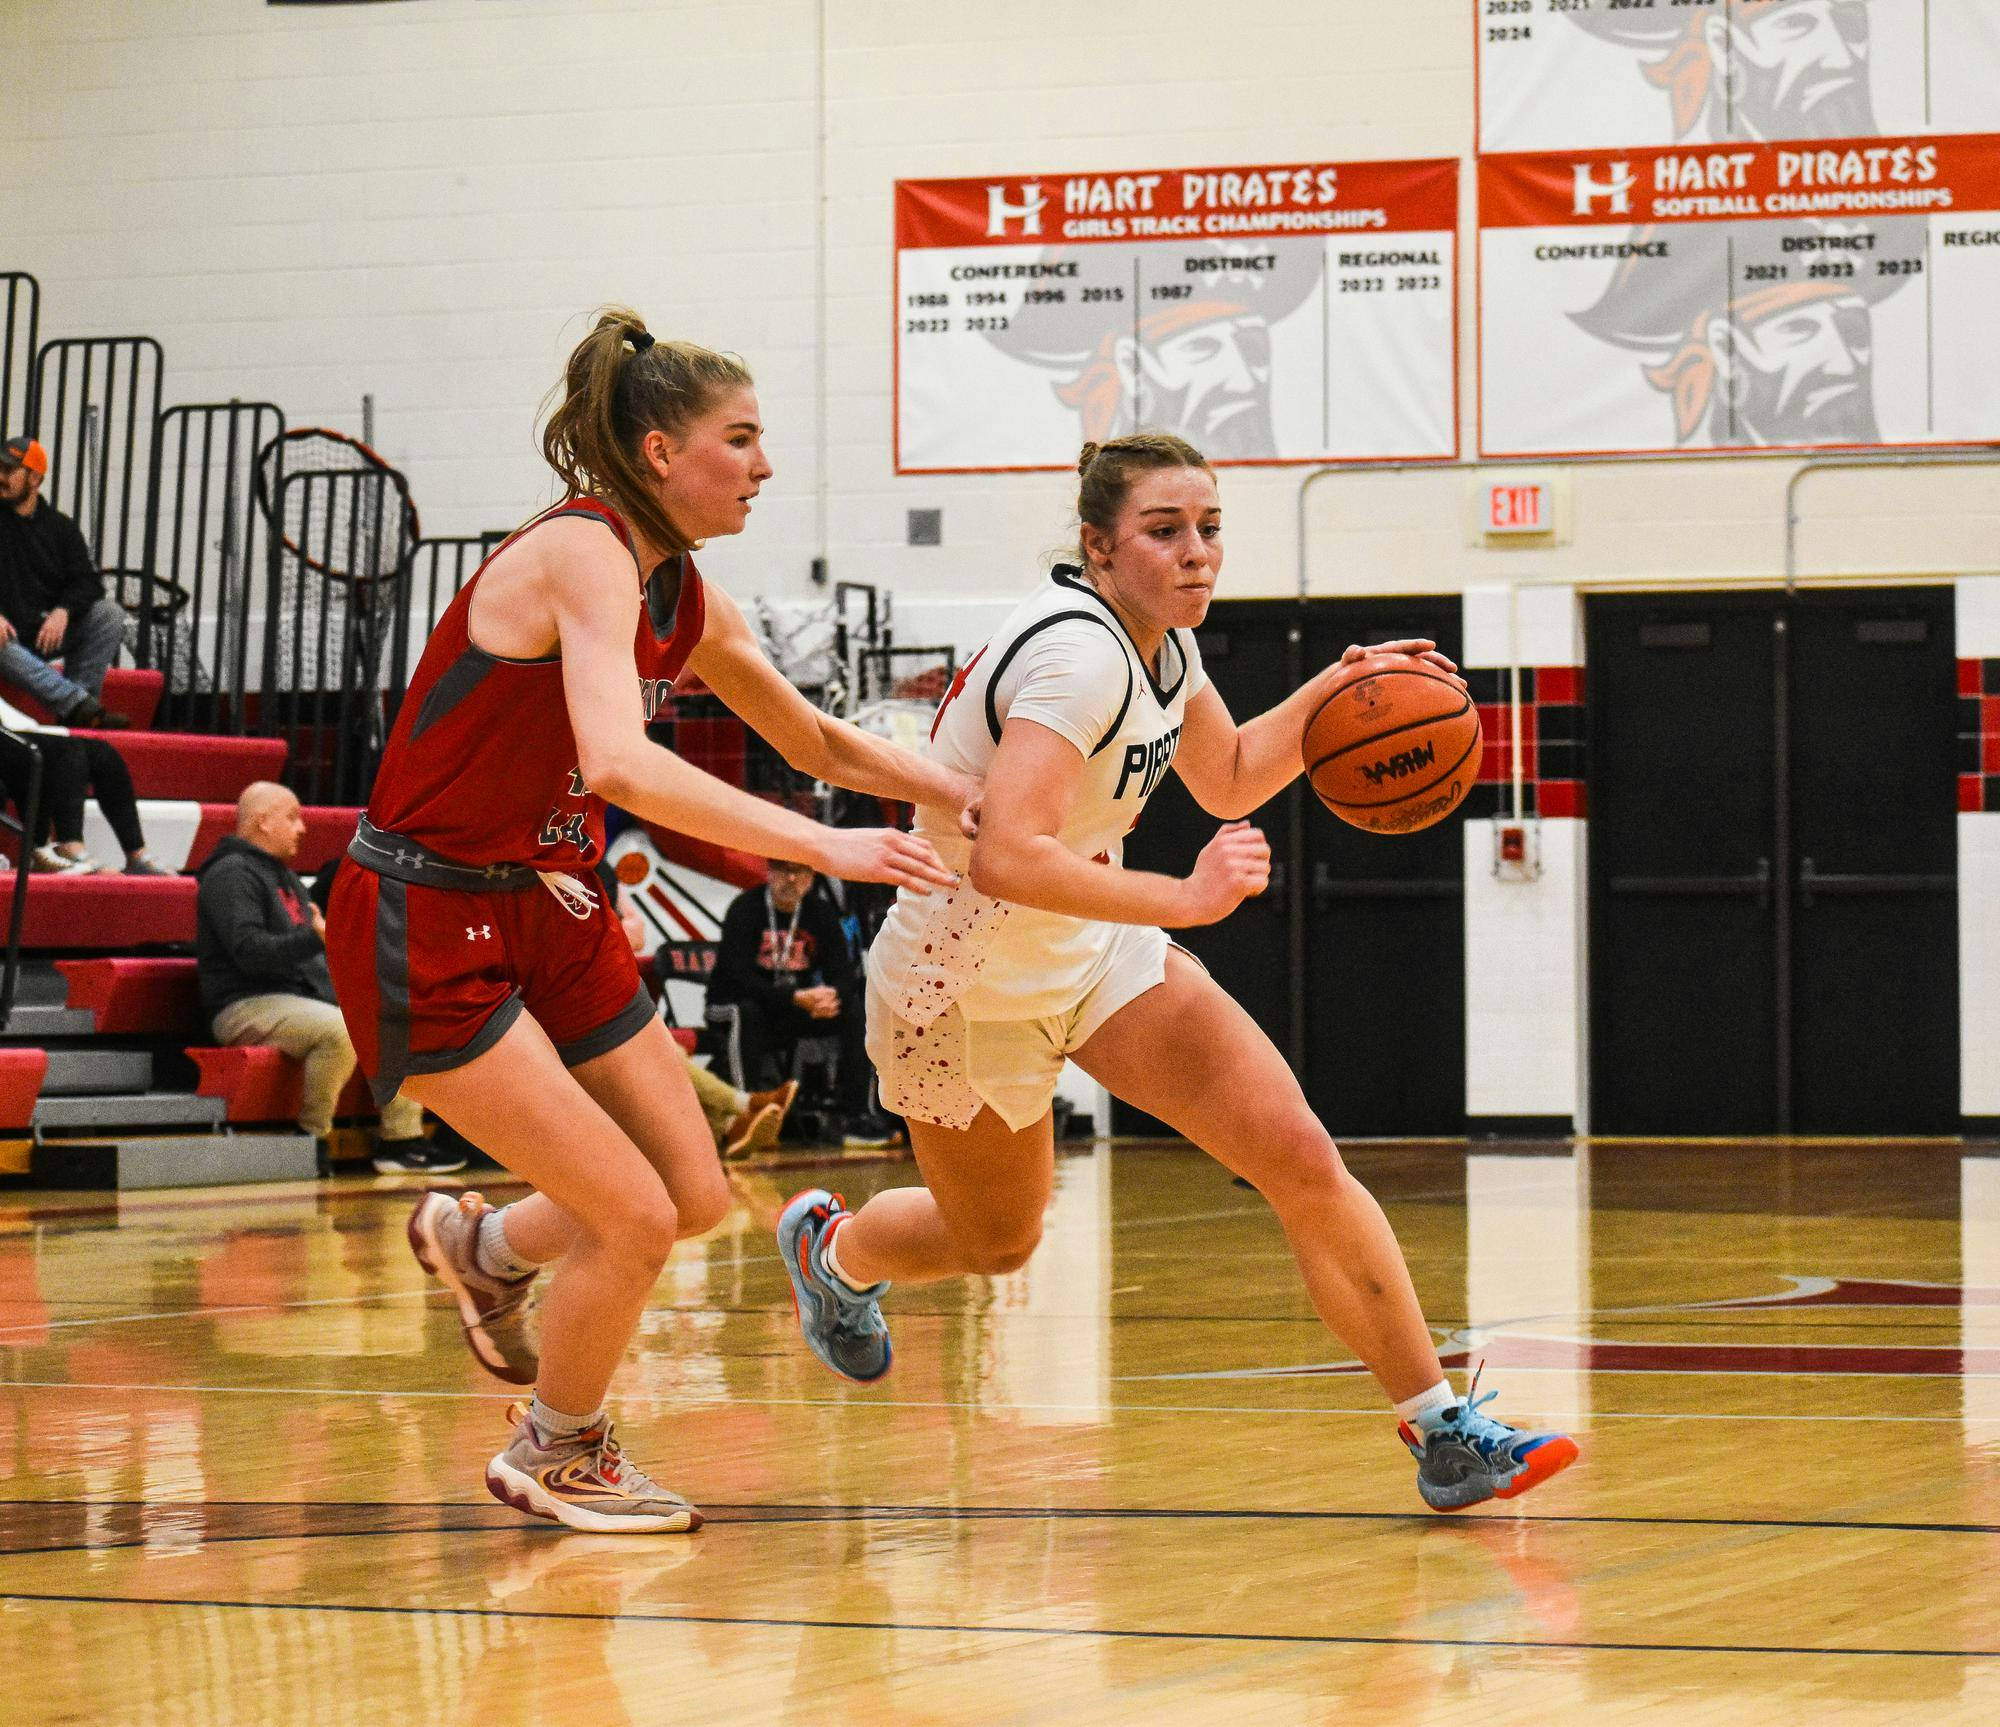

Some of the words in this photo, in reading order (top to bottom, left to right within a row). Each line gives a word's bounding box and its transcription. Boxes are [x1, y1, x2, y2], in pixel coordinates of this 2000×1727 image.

[1654, 152, 1756, 192] HART
[1777, 145, 1937, 188] PIRATES
[1063, 174, 1161, 214] HART
[1182, 168, 1338, 210] PIRATES
[1652, 195, 1761, 217] SOFTBALL
[1764, 188, 1953, 213] CHAMPIONSHIPS
[1062, 216, 1127, 238] GIRLS
[1130, 214, 1201, 236] TRACK
[1204, 208, 1388, 234] CHAMPIONSHIPS
[1535, 241, 1669, 261] CONFERENCE
[1781, 233, 1876, 252] DISTRICT
[950, 262, 1079, 281] CONFERENCE
[1185, 255, 1277, 273] DISTRICT
[1338, 251, 1440, 267] REGIONAL
[1490, 485, 1542, 526] EXIT
[1113, 724, 1184, 800] PIRAT
